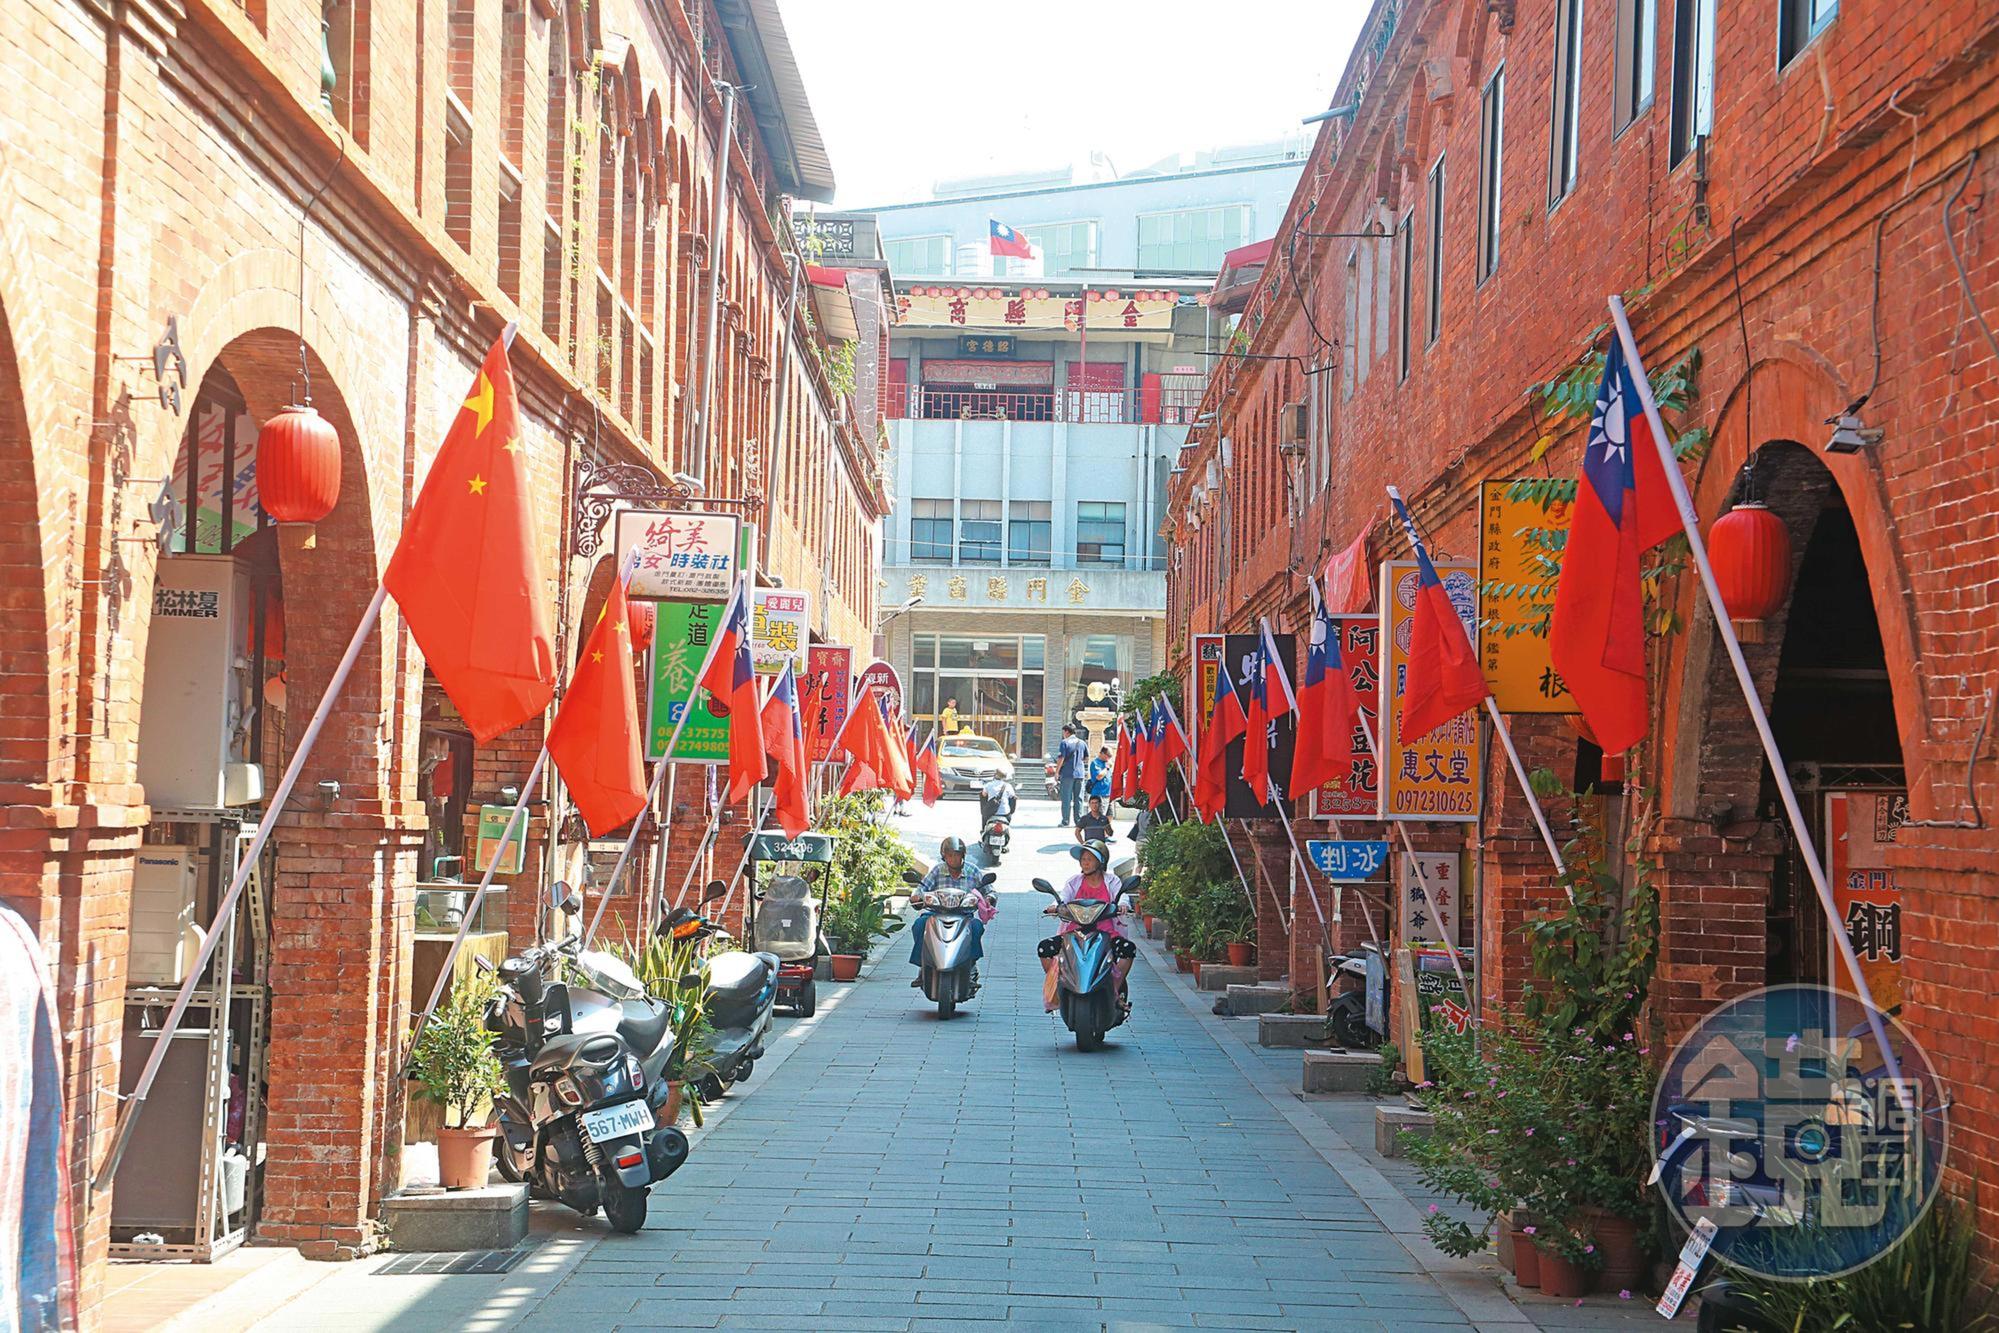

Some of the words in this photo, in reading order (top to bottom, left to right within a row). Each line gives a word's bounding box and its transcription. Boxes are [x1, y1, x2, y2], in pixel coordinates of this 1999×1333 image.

[880, 573, 1090, 603] 金門縣商業
[151, 608, 218, 618] UMMER
[1399, 749, 1470, 784] 惠文堂
[1396, 790, 1472, 812] 0972310625
[773, 842, 814, 853] 324206
[139, 857, 179, 865] Panasonic
[1847, 871, 1900, 891] 金門
[1846, 901, 1902, 962] 鋼
